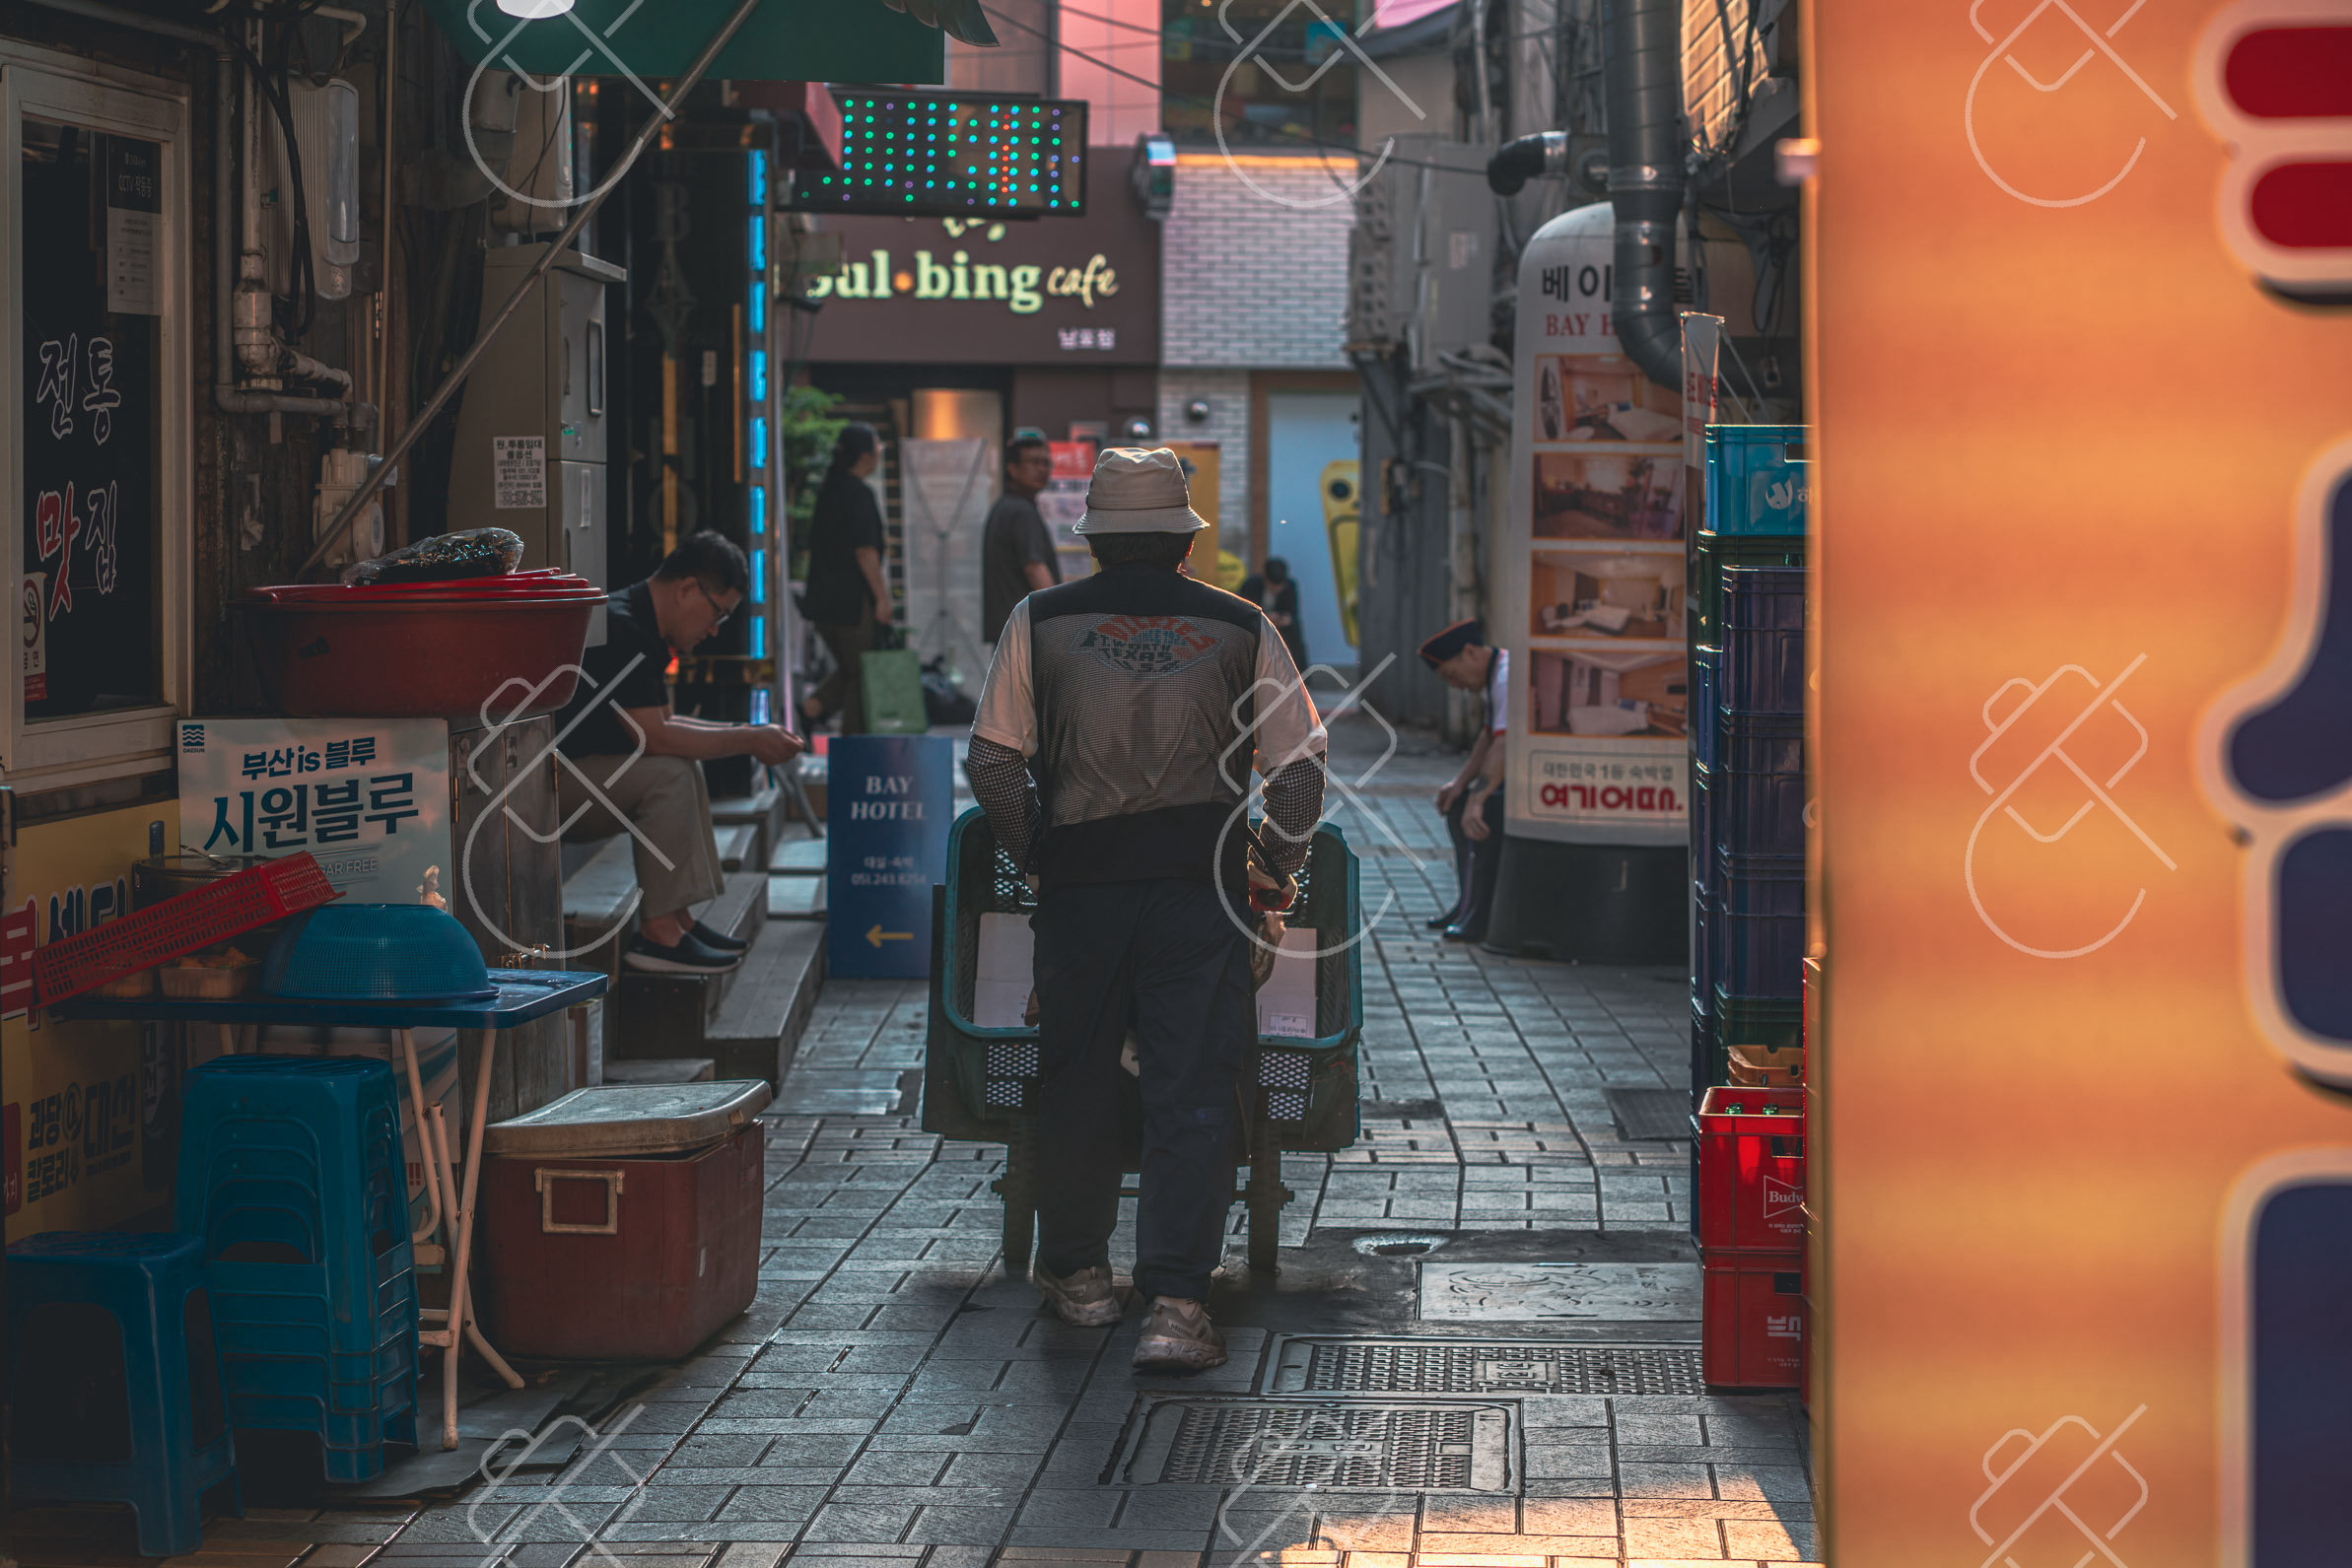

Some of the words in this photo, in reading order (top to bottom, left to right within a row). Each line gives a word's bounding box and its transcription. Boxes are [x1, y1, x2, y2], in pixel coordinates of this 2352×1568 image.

[118, 174, 133, 192] CCTV
[1046, 253, 1120, 308] cafe
[1545, 313, 1590, 337] BAY
[36, 332, 120, 445] 전통
[36, 480, 117, 622] 맛집
[242, 747, 295, 781] 부산
[297, 745, 321, 774] is
[324, 736, 377, 770] 블루
[865, 775, 914, 794] BAY
[203, 773, 419, 852] 시원블루
[851, 801, 928, 820] HOTEL
[346, 858, 379, 873] FREE
[29, 1093, 61, 1150] 과당
[28, 1148, 69, 1203] 칼로리
